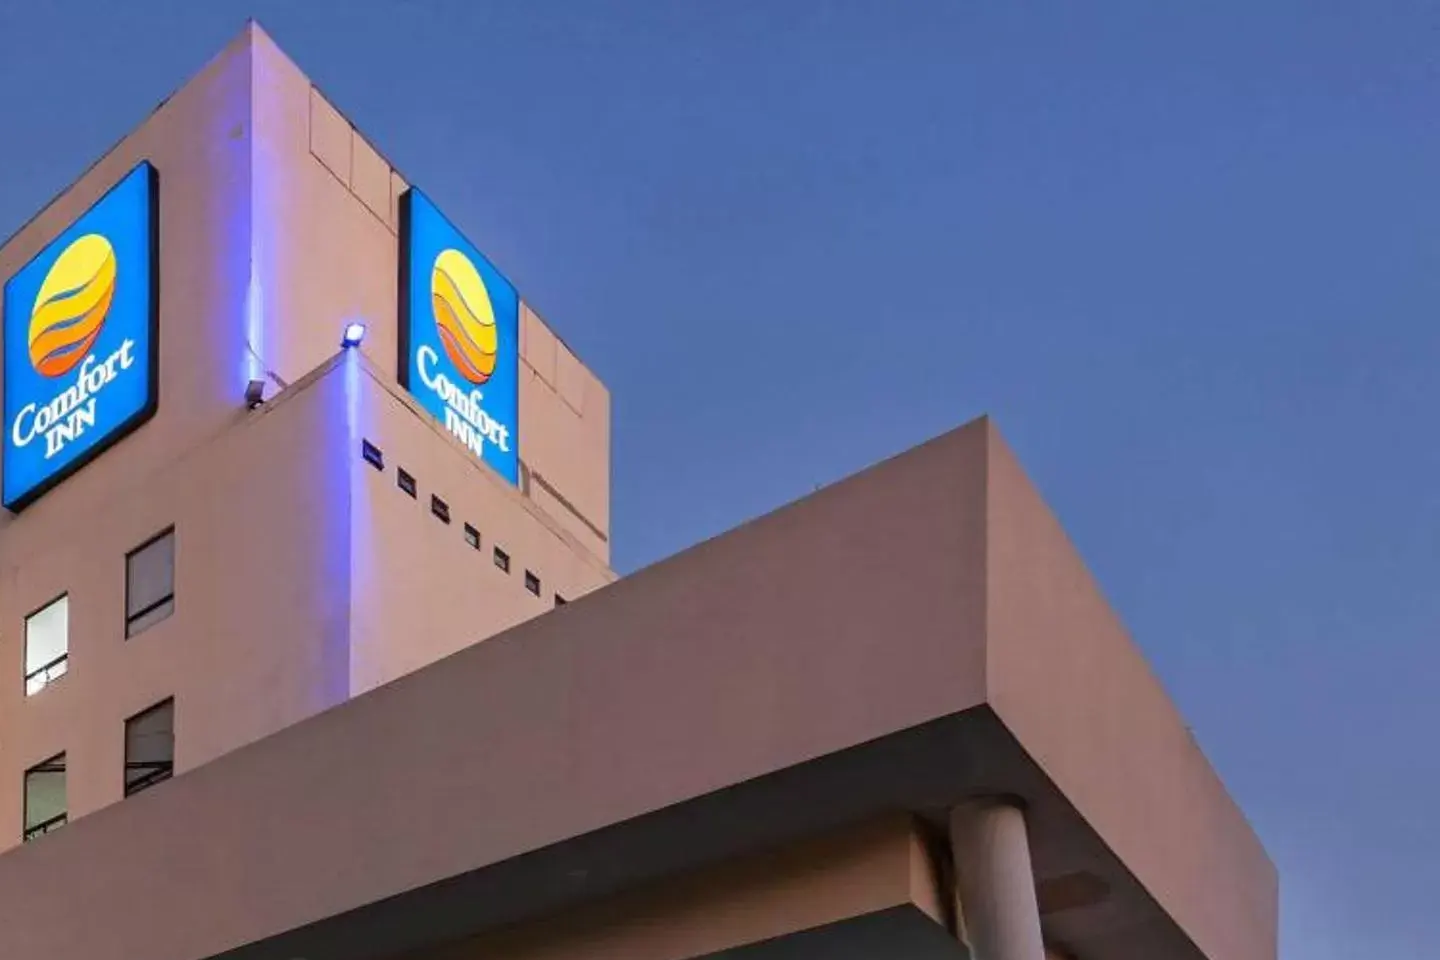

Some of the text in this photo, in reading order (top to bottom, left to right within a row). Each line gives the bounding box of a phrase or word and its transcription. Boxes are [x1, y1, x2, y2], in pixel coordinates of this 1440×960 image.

[12, 338, 134, 447] Comfort
[44, 398, 96, 459] INN
[417, 344, 511, 452] Comfort
[444, 406, 484, 459] INN
